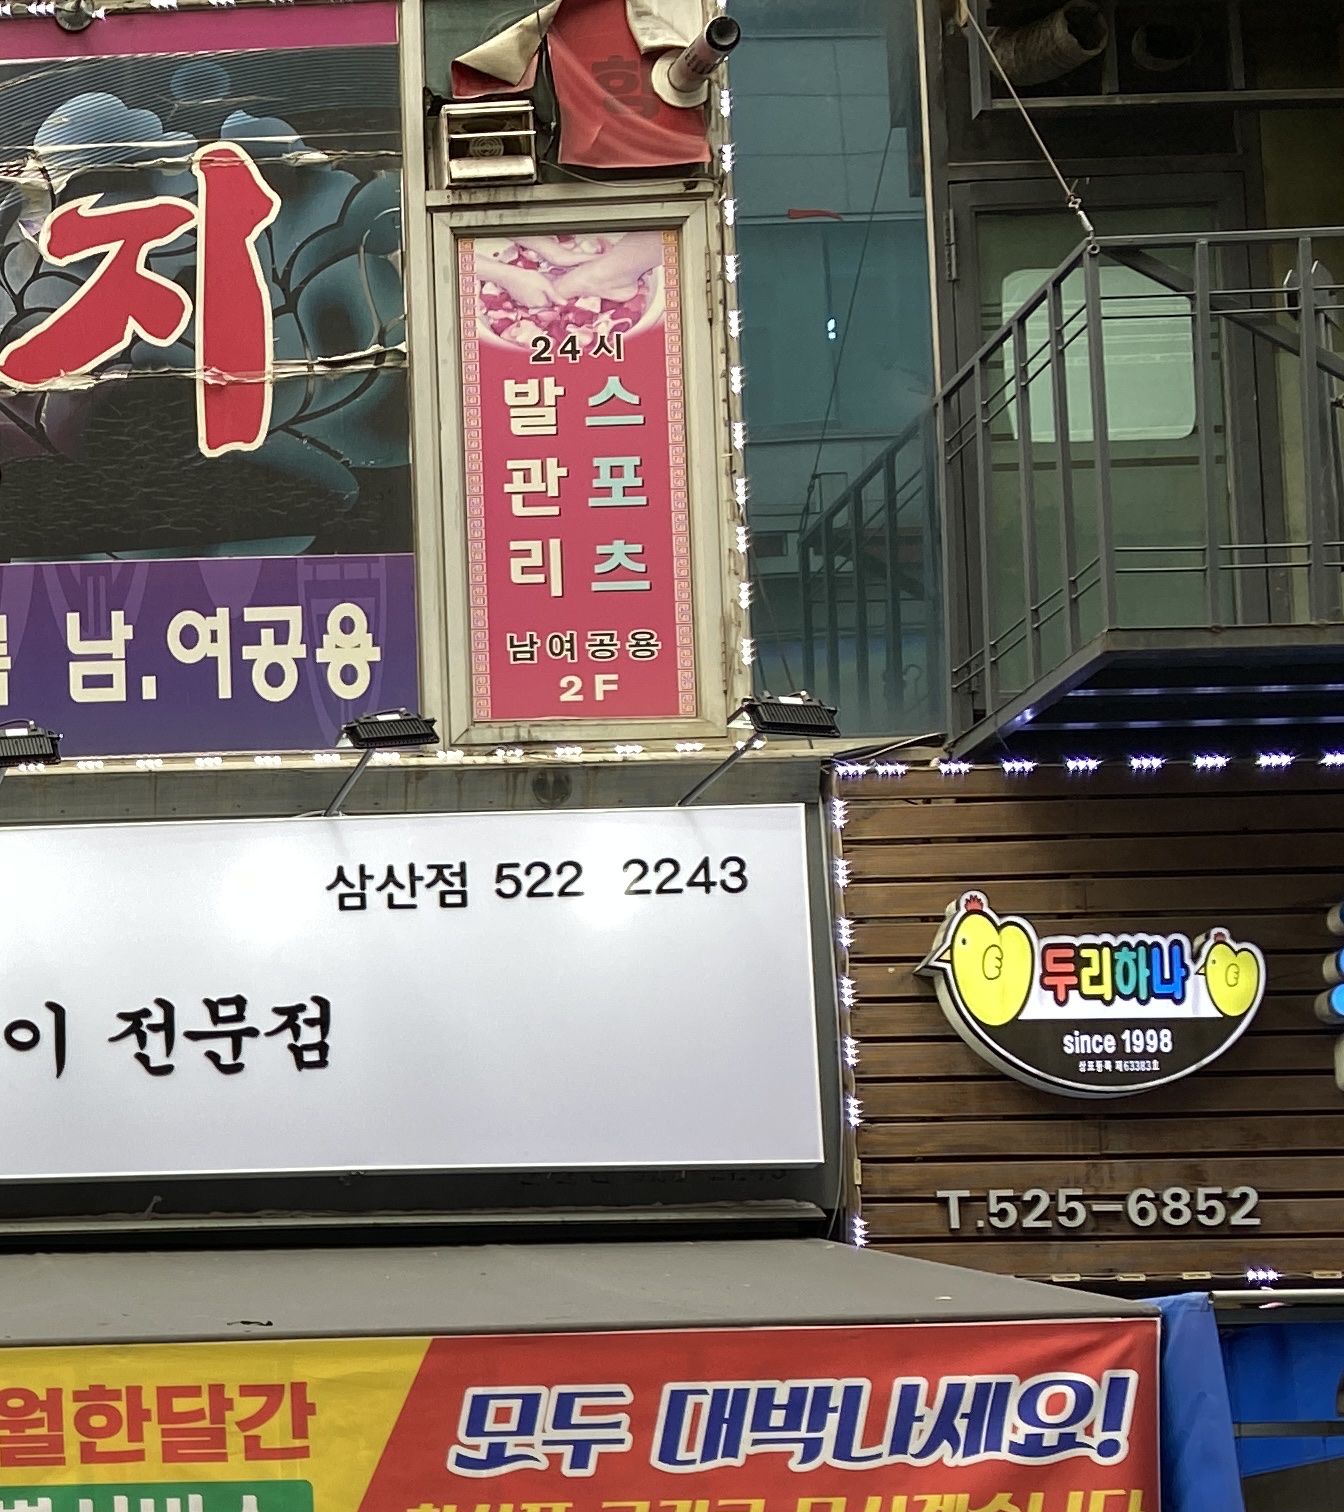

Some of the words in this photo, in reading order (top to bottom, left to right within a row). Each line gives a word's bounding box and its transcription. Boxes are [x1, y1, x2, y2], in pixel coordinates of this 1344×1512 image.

[530, 333, 624, 362] 24시
[506, 630, 661, 662] 남여공용
[559, 674, 619, 702] 2F
[324, 860, 470, 912] 삼산점
[494, 861, 584, 899] 522
[621, 855, 749, 897] 2243
[1041, 942, 1189, 1005] 두리하나
[110, 995, 333, 1077] 전문점
[1062, 1030, 1116, 1054] since
[1121, 1028, 1173, 1053] 1998
[936, 1186, 1261, 1230] T.525-6852
[447, 1383, 631, 1478] 모두
[651, 1370, 1135, 1478] 대박나세요!
